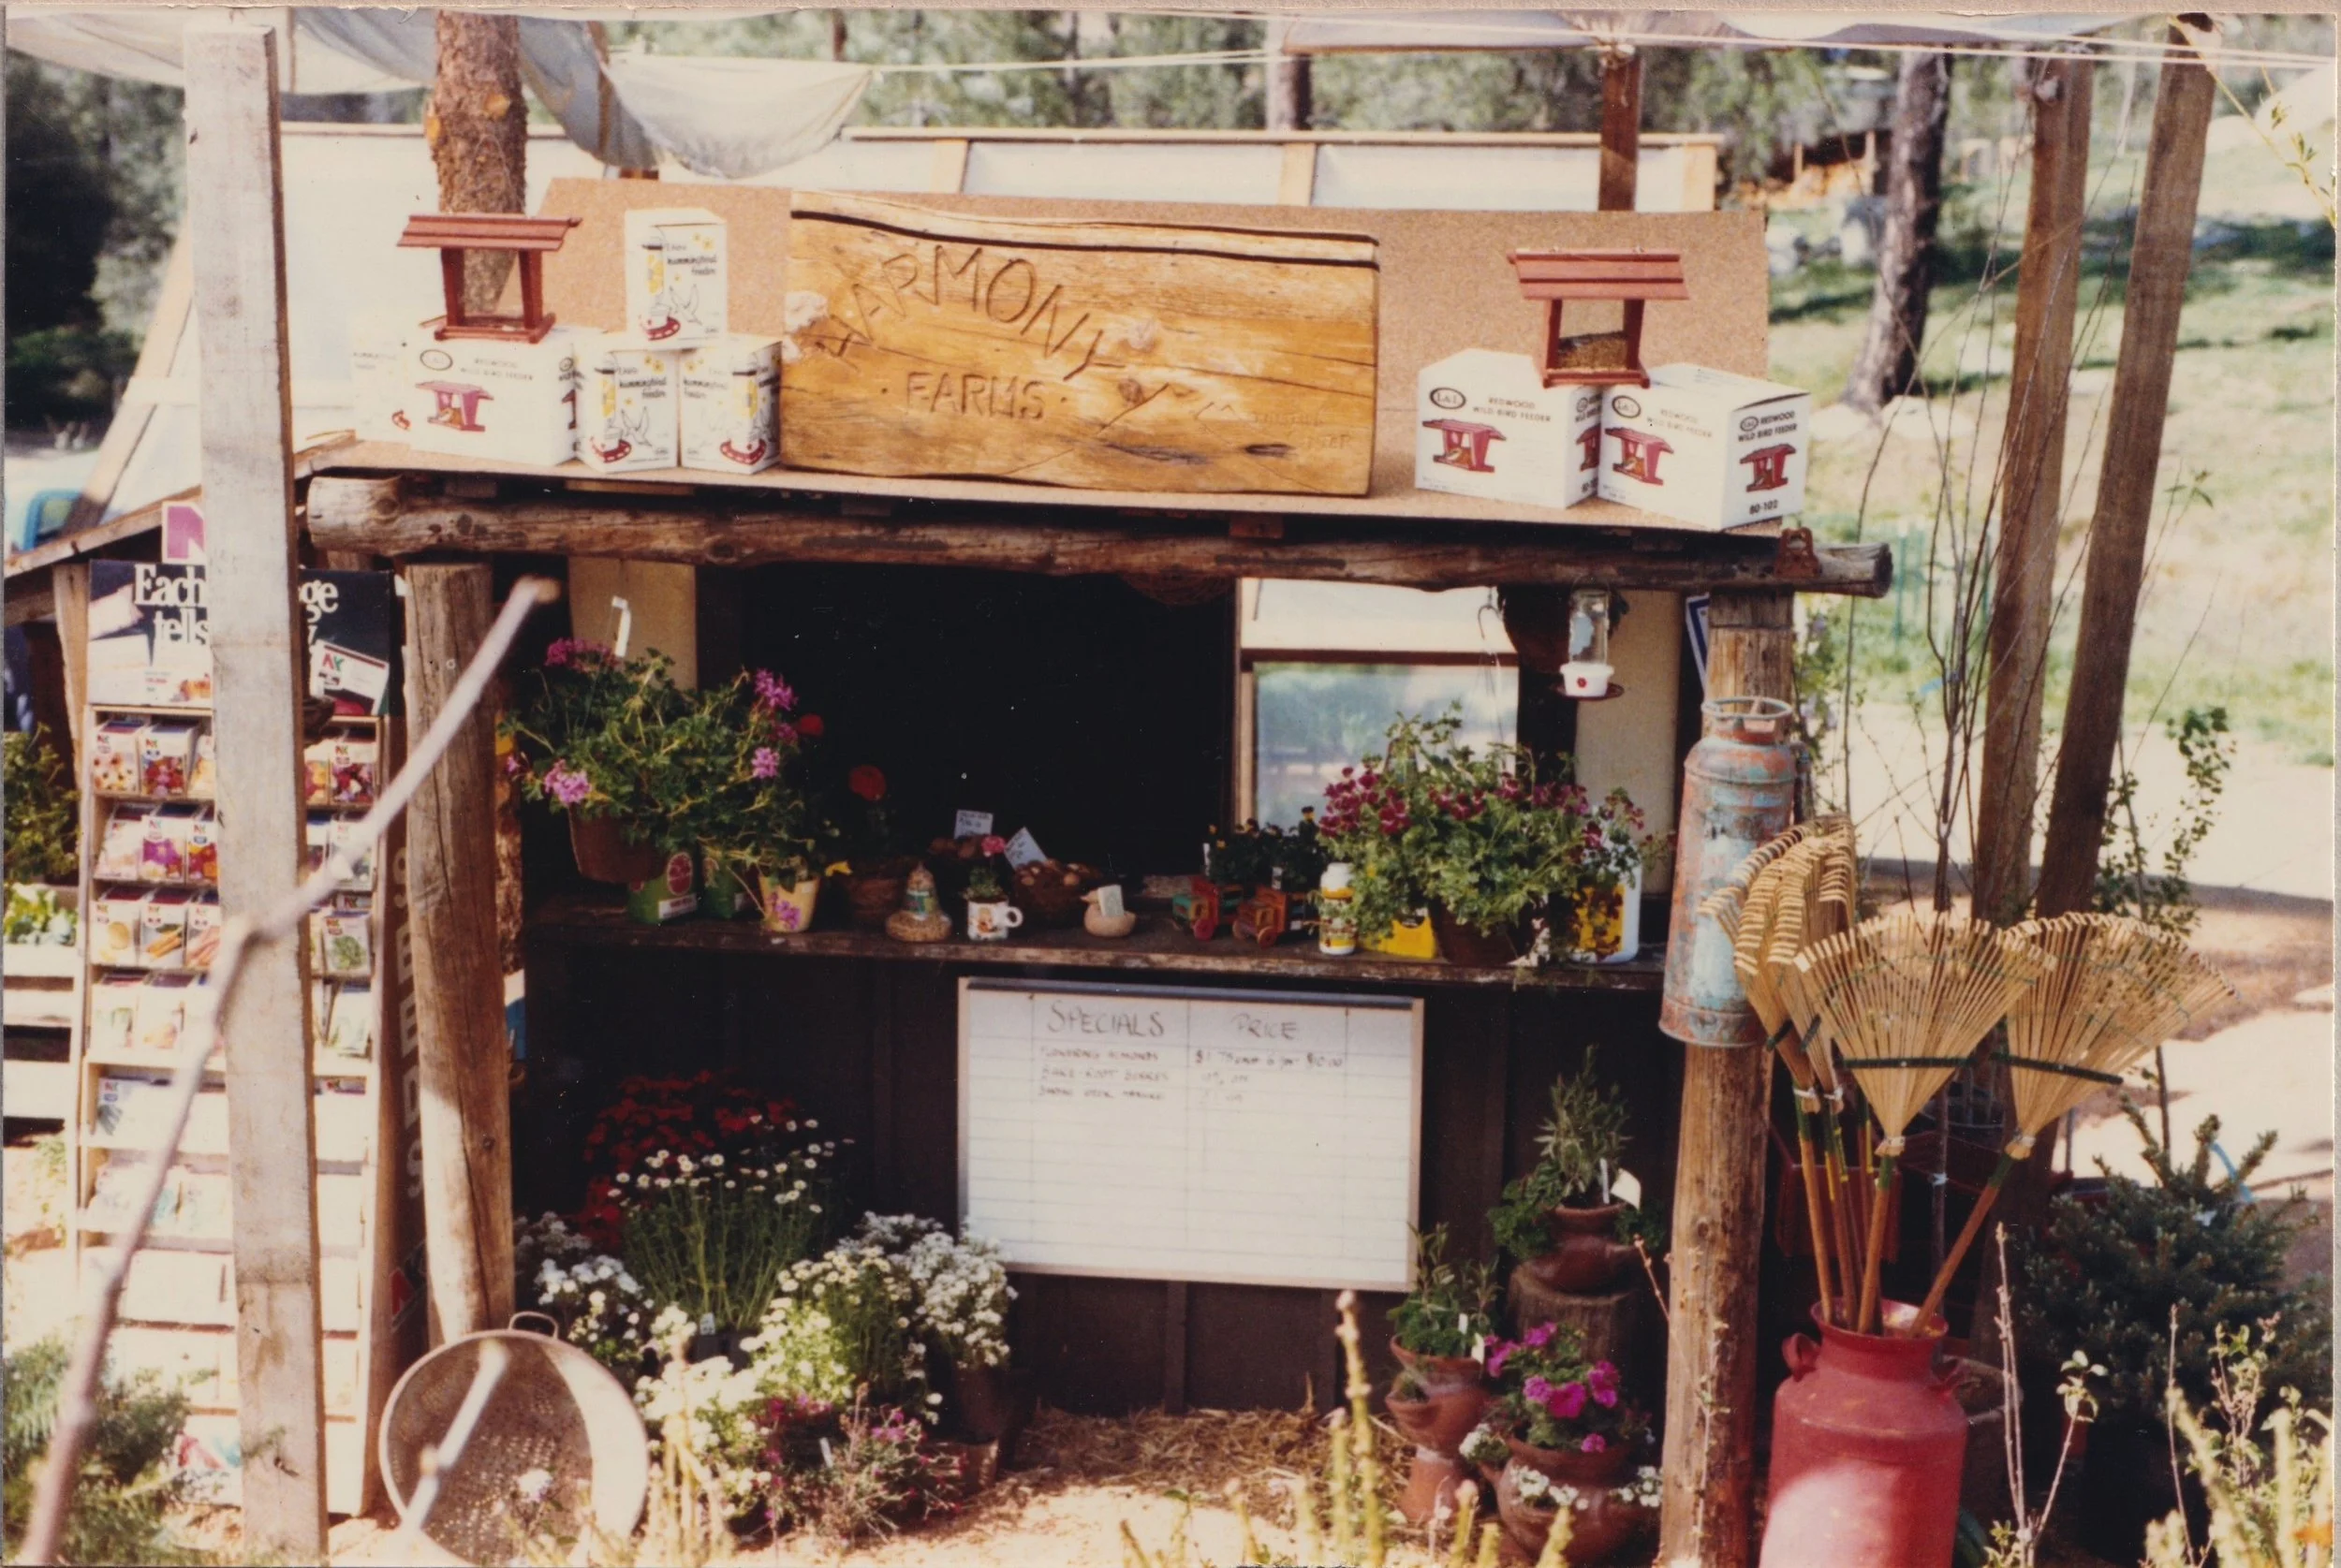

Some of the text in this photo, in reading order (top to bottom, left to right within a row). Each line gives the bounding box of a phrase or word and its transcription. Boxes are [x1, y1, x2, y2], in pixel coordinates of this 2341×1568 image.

[814, 244, 1127, 382] HARMONY
[905, 370, 1045, 420] FARMS
[1473, 406, 1552, 422] WILD BIRD FEEDER
[1488, 397, 1536, 408] REDWOOD
[1738, 422, 1798, 443] WILD BIRD FEEDER
[1760, 410, 1795, 424] REDWOOD
[135, 564, 206, 606] Each
[154, 607, 209, 646] tells
[1047, 999, 1300, 1040] SPECIALS PRICE
